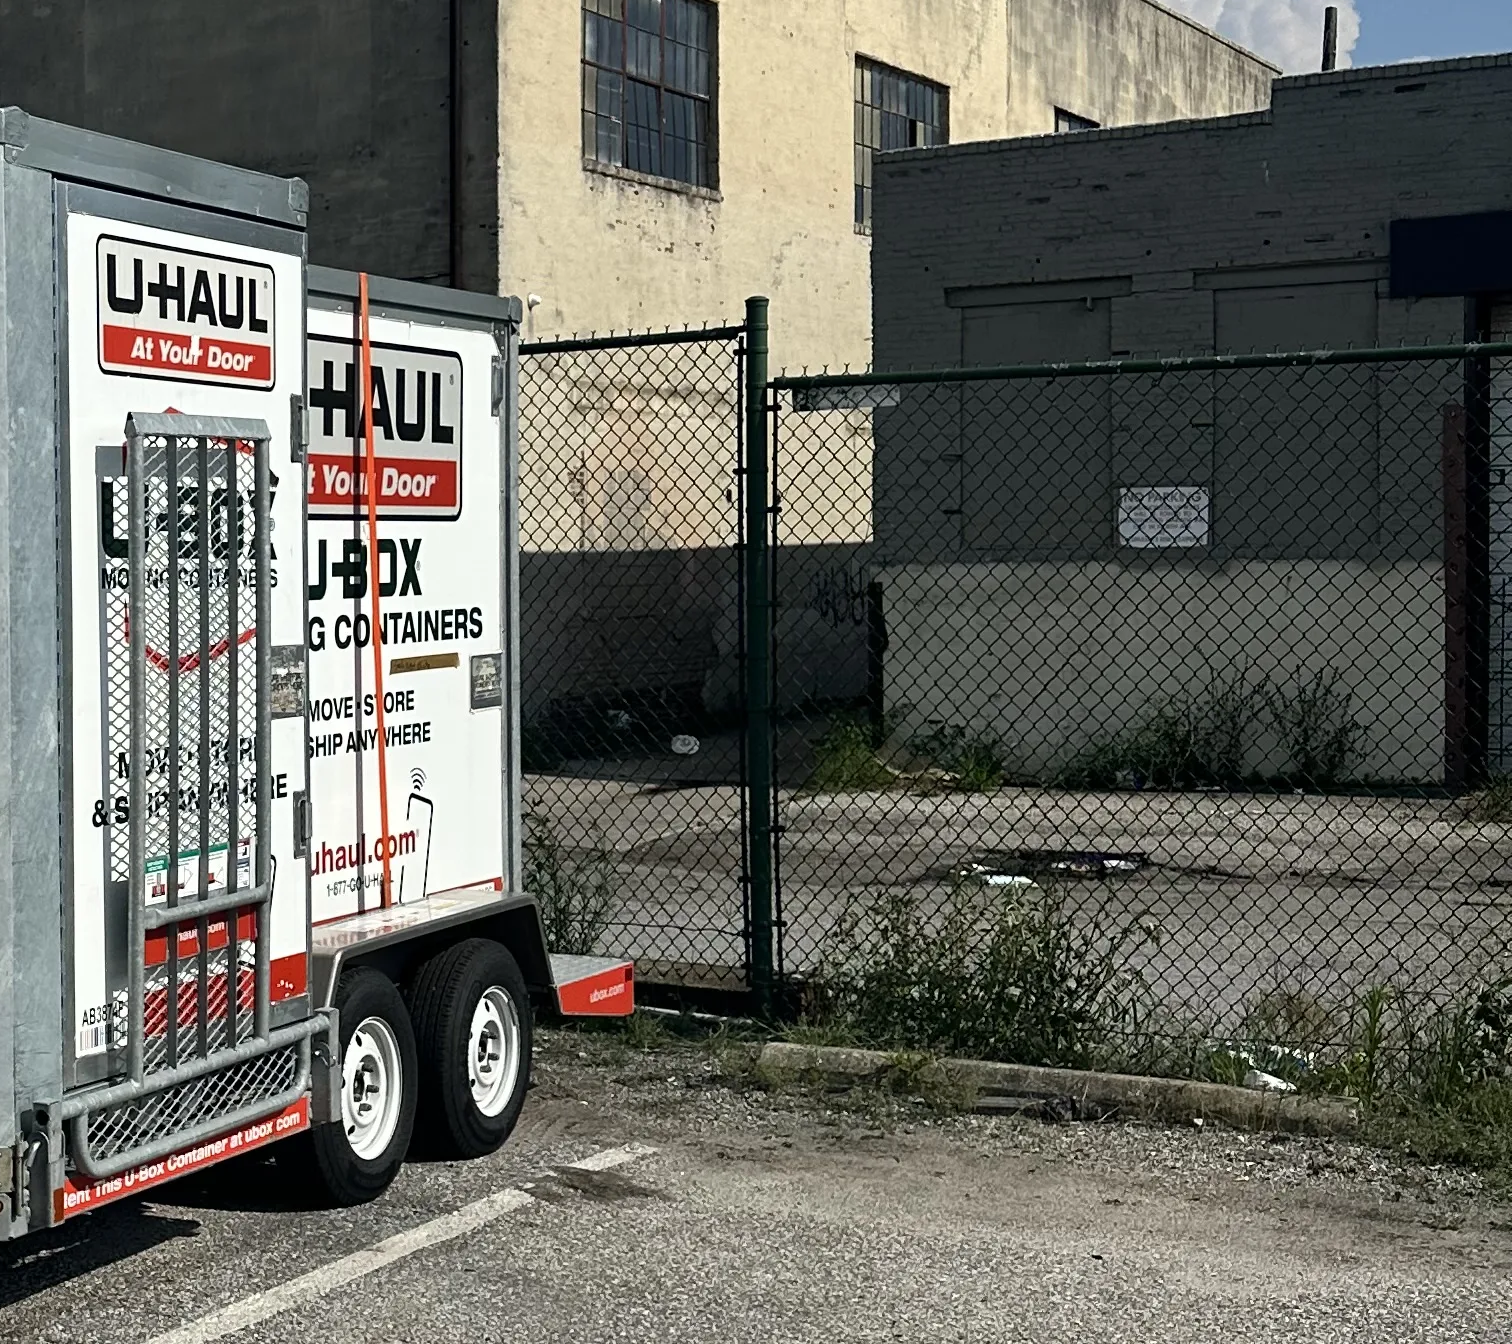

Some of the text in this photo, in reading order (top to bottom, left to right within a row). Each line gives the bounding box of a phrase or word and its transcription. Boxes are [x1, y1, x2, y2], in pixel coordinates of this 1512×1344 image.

[106, 253, 268, 334] U-HAUL
[131, 336, 254, 372] At Your Door
[381, 467, 437, 497] Door
[124, 1161, 166, 1188] U-Box
[167, 1137, 229, 1171] Container
[230, 1131, 243, 1149] at
